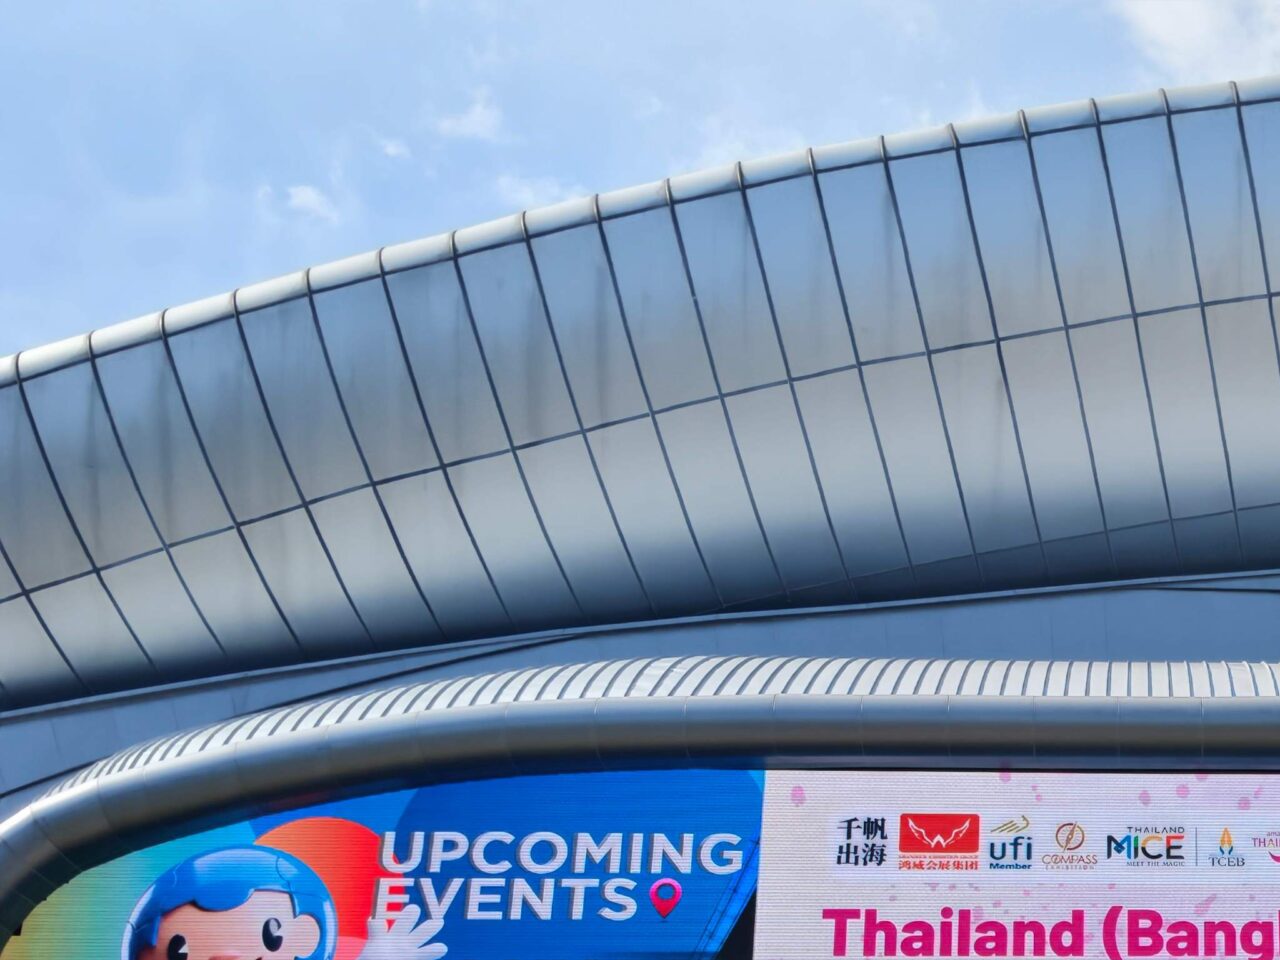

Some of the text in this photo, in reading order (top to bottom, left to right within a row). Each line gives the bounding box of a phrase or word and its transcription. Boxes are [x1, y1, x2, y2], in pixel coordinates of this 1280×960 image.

[837, 816, 888, 841] 千帆
[1127, 826, 1185, 834] THAILAND
[380, 831, 744, 876] UPCOMING
[836, 842, 888, 867] 出海
[989, 835, 1033, 861] ufi
[1042, 854, 1098, 865] COMPASS
[1106, 834, 1185, 860] MICE
[1207, 856, 1246, 867] TCEB
[374, 877, 638, 921] EVENTS
[822, 906, 1085, 958] Thailand
